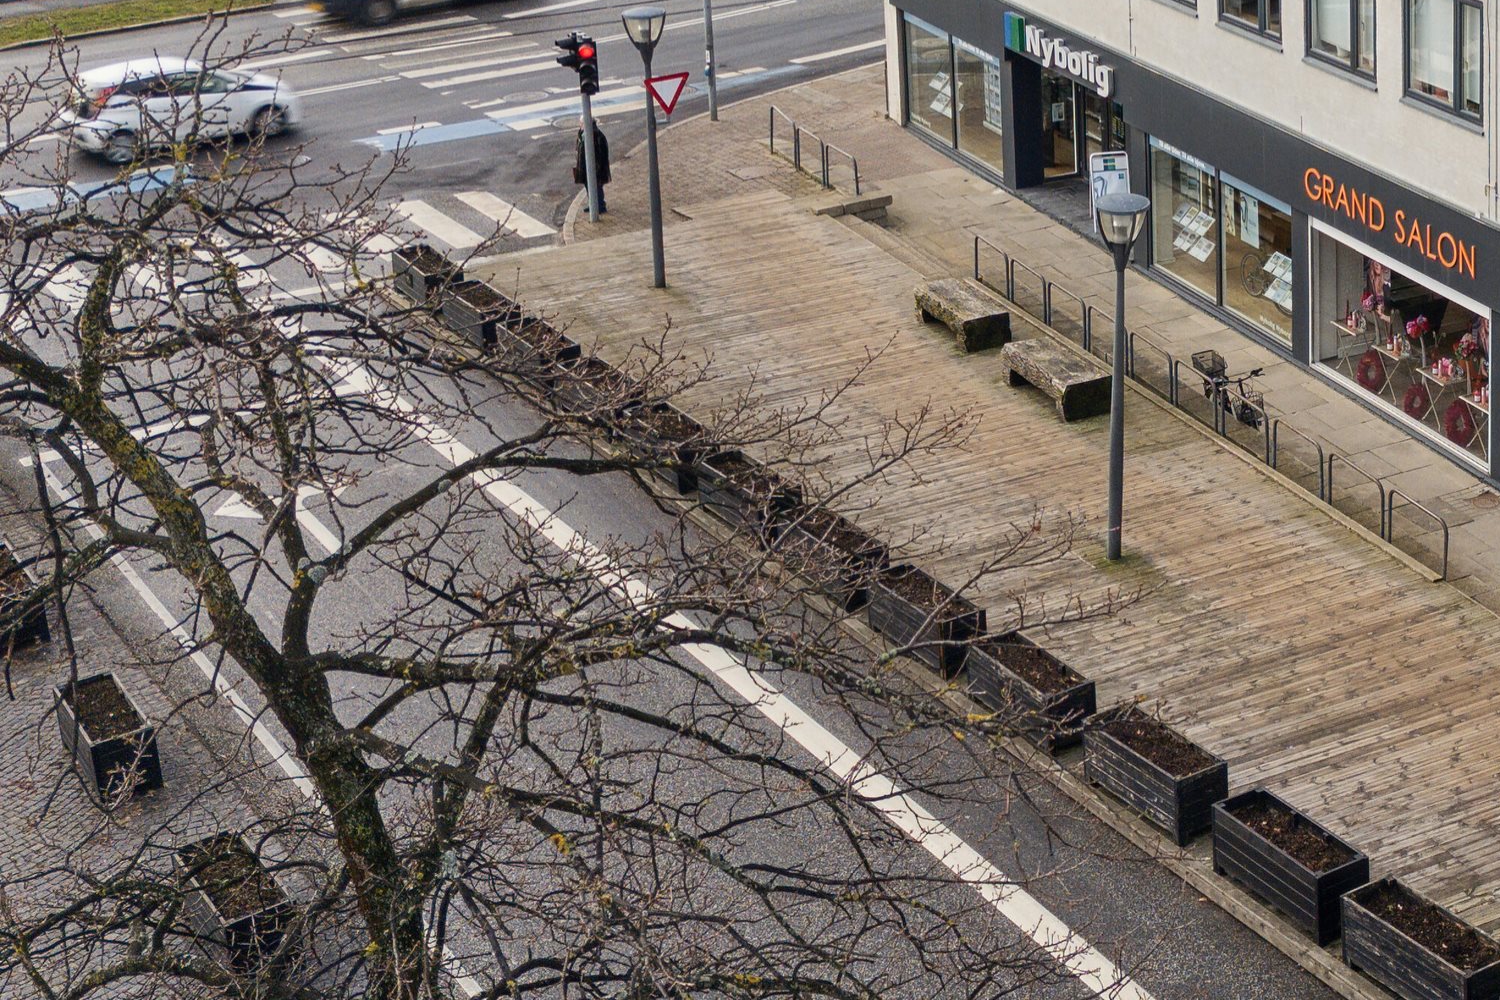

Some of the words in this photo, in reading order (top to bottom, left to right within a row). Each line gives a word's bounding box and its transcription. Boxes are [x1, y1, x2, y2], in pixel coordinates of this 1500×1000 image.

[1026, 24, 1113, 98] Nybolig
[1304, 167, 1385, 232] GRAND
[1394, 210, 1476, 280] SALON
